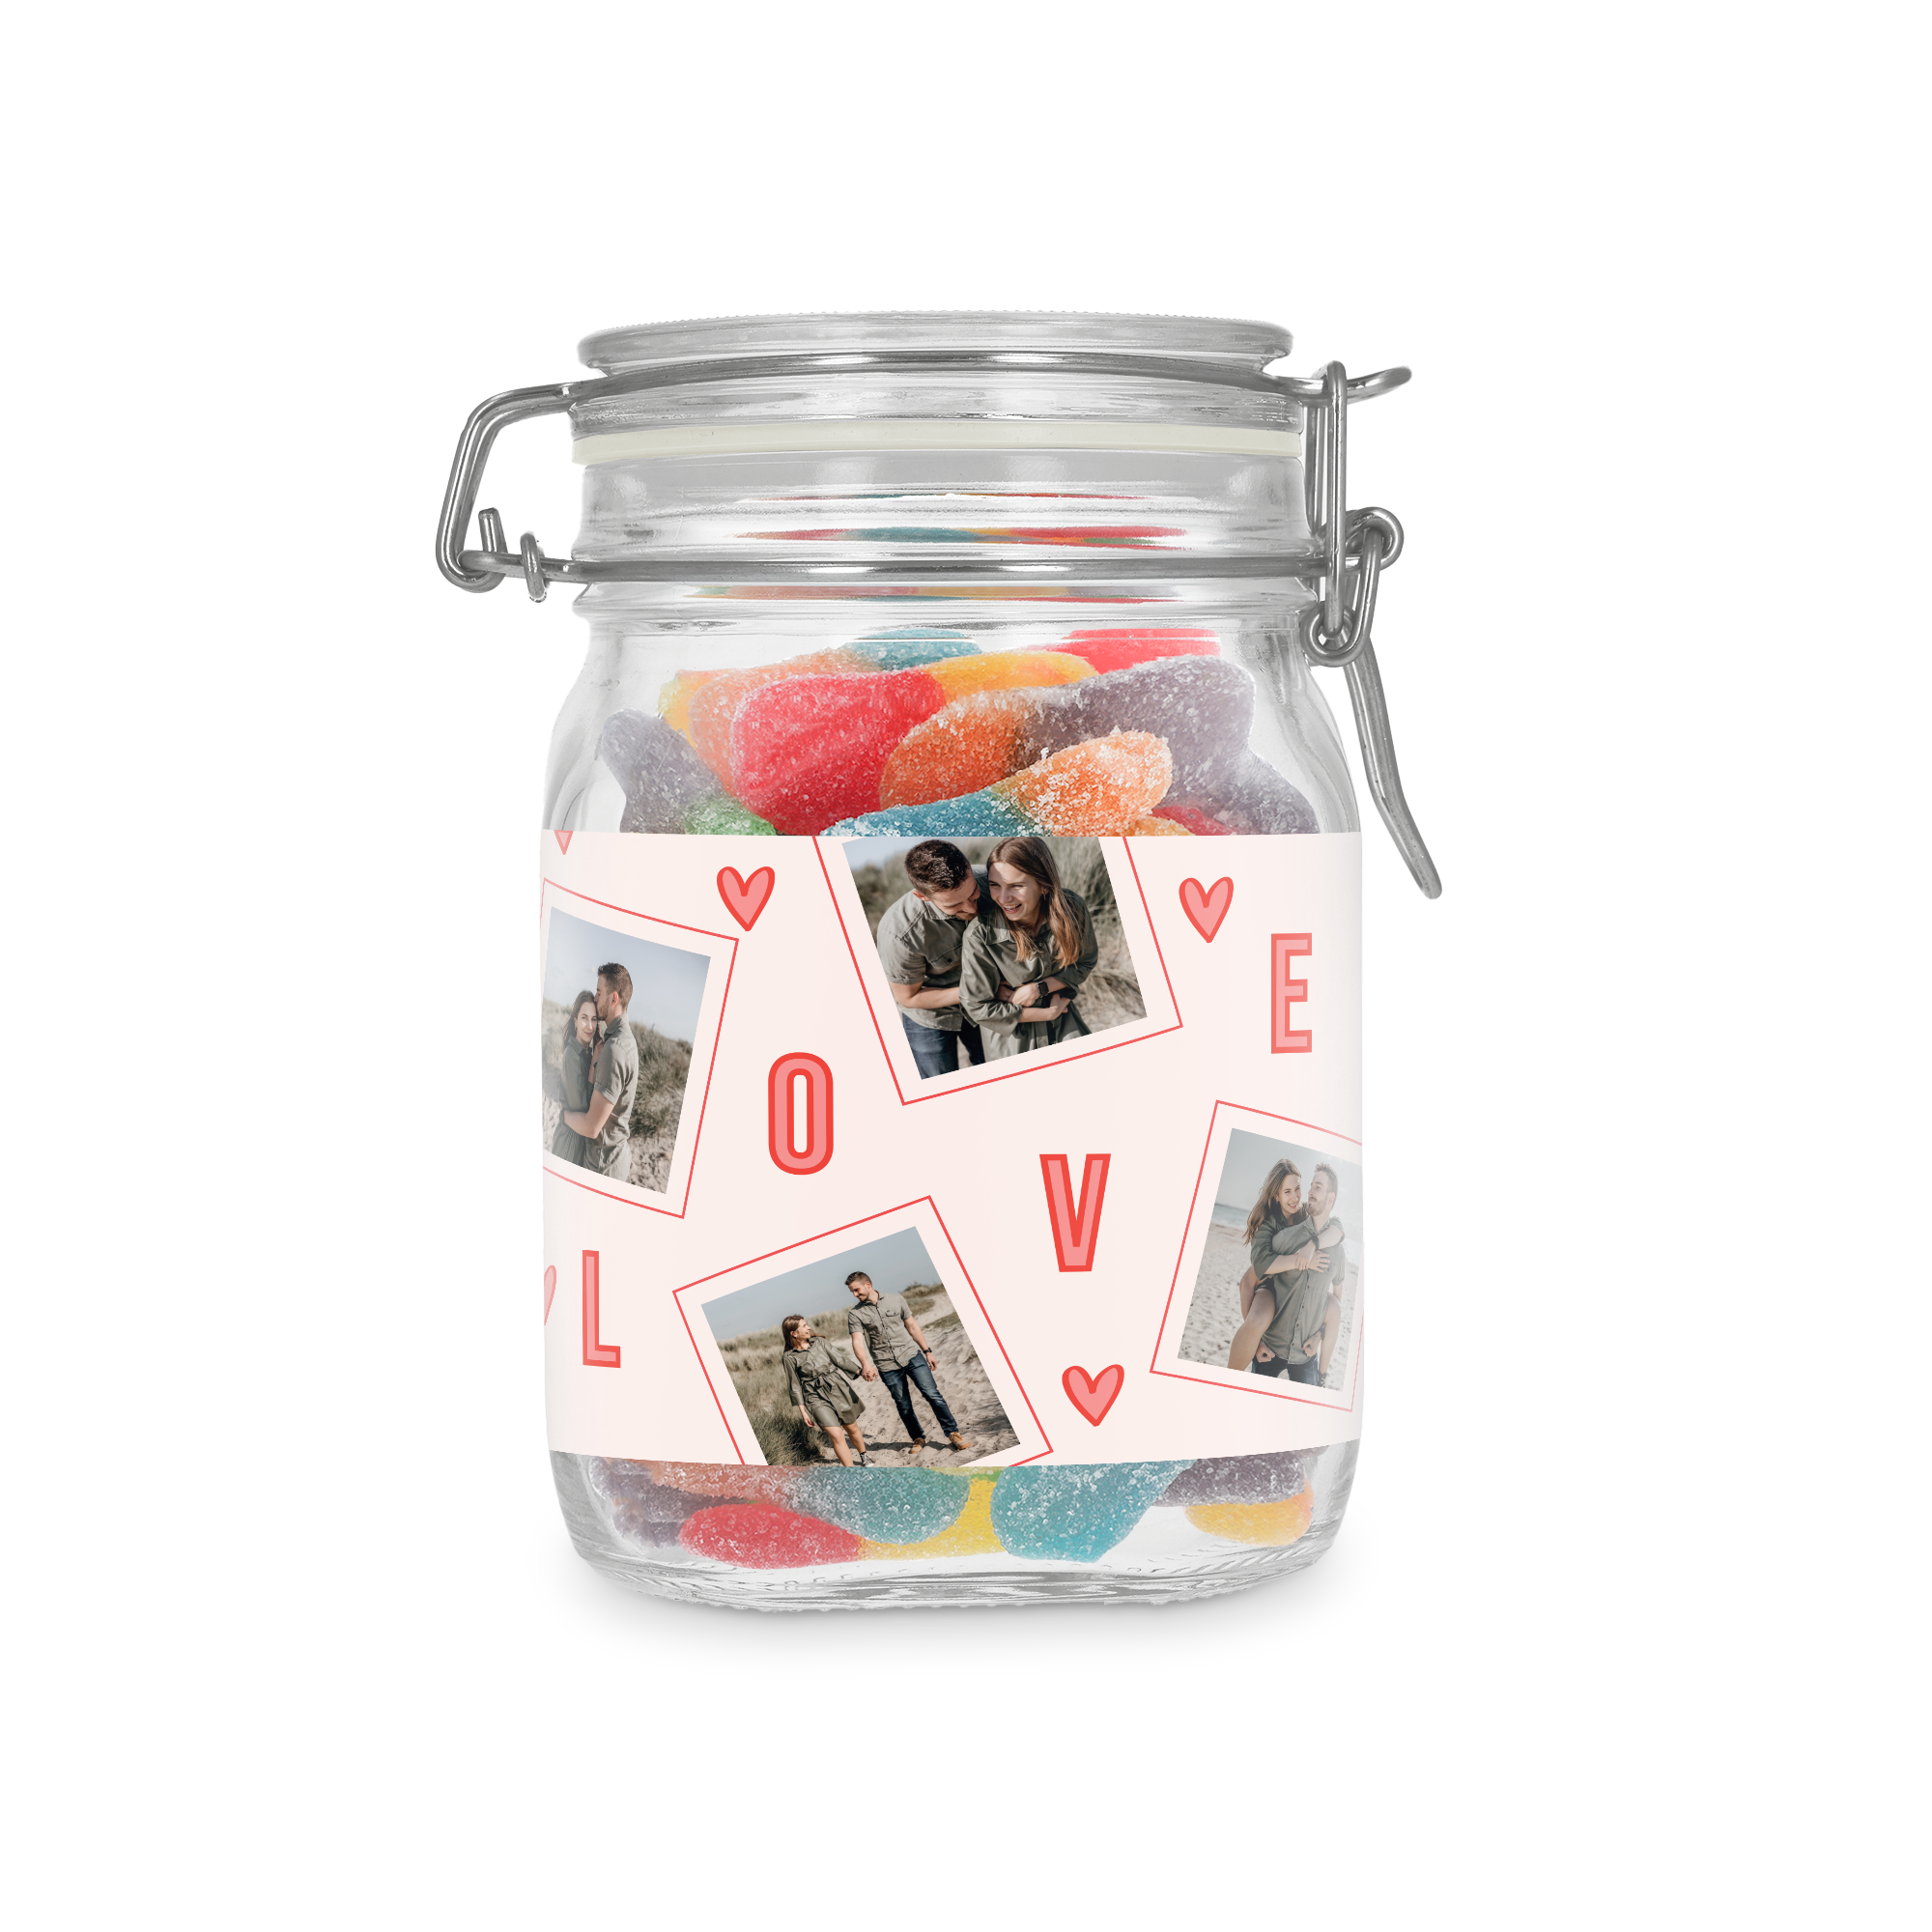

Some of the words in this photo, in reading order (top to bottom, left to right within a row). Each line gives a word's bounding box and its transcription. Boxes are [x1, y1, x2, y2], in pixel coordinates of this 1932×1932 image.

[582, 1249, 621, 1369] L
[767, 1051, 835, 1176] O
[1038, 1152, 1112, 1273] V
[1270, 932, 1313, 1055] E
